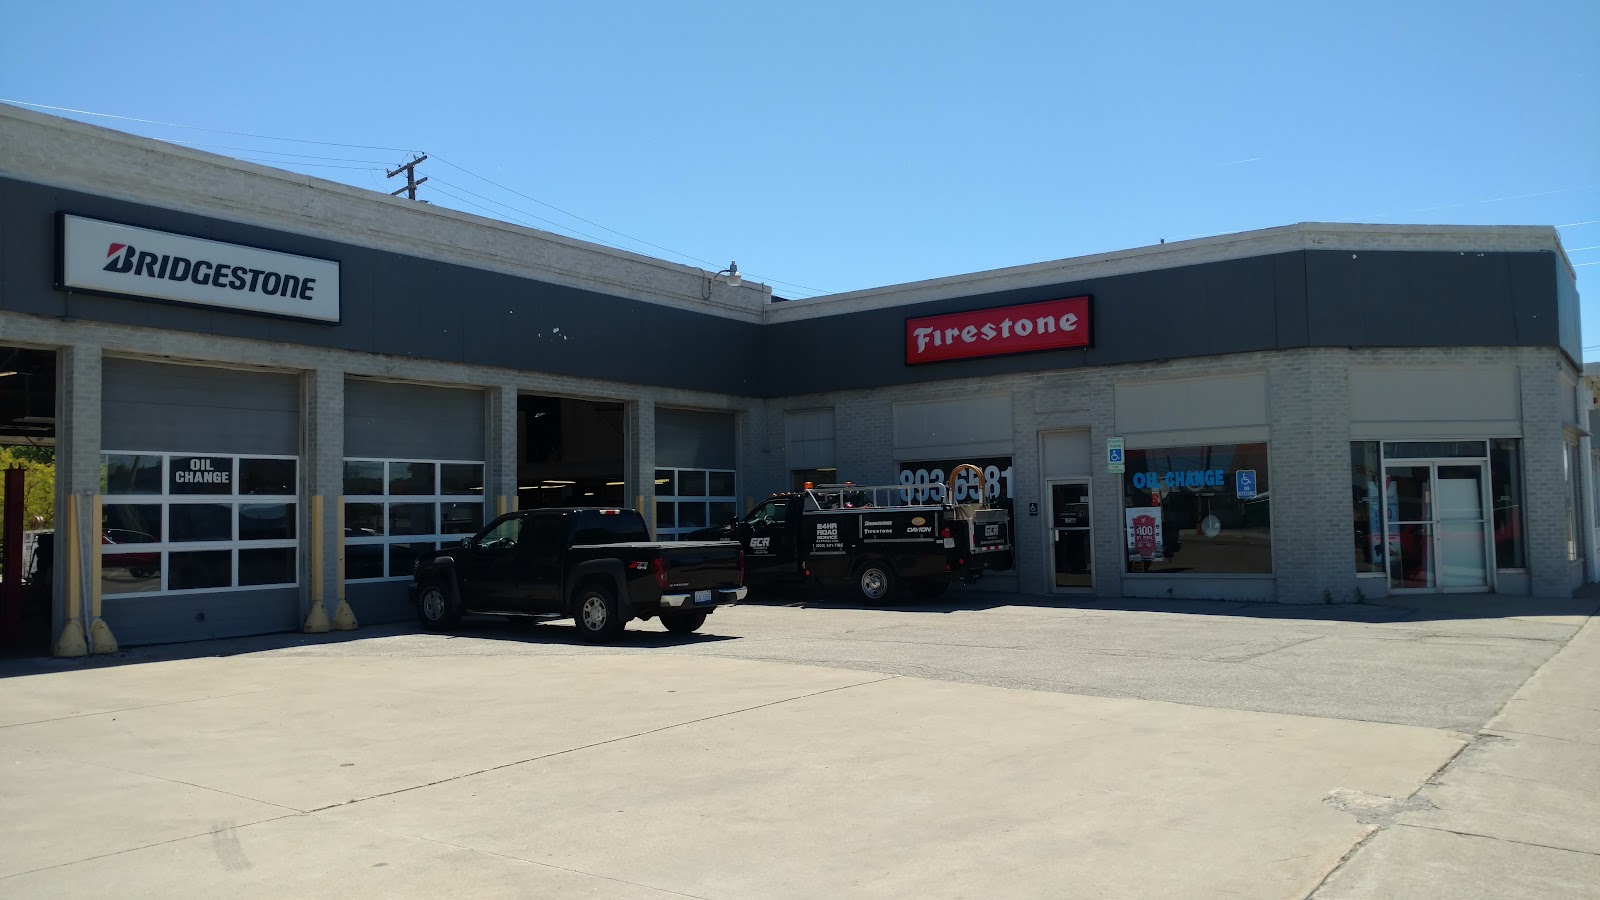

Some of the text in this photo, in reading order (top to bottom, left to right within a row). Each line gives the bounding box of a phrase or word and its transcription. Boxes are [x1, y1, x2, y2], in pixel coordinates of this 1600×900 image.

[102, 242, 316, 300] BRIDGESTONE
[913, 313, 1078, 353] Firestone
[190, 459, 214, 470] OIL
[176, 471, 229, 483] CHANGE
[900, 465, 1013, 502] 8936581
[1133, 470, 1225, 489] OIL CHANGE
[750, 537, 771, 547] GCR
